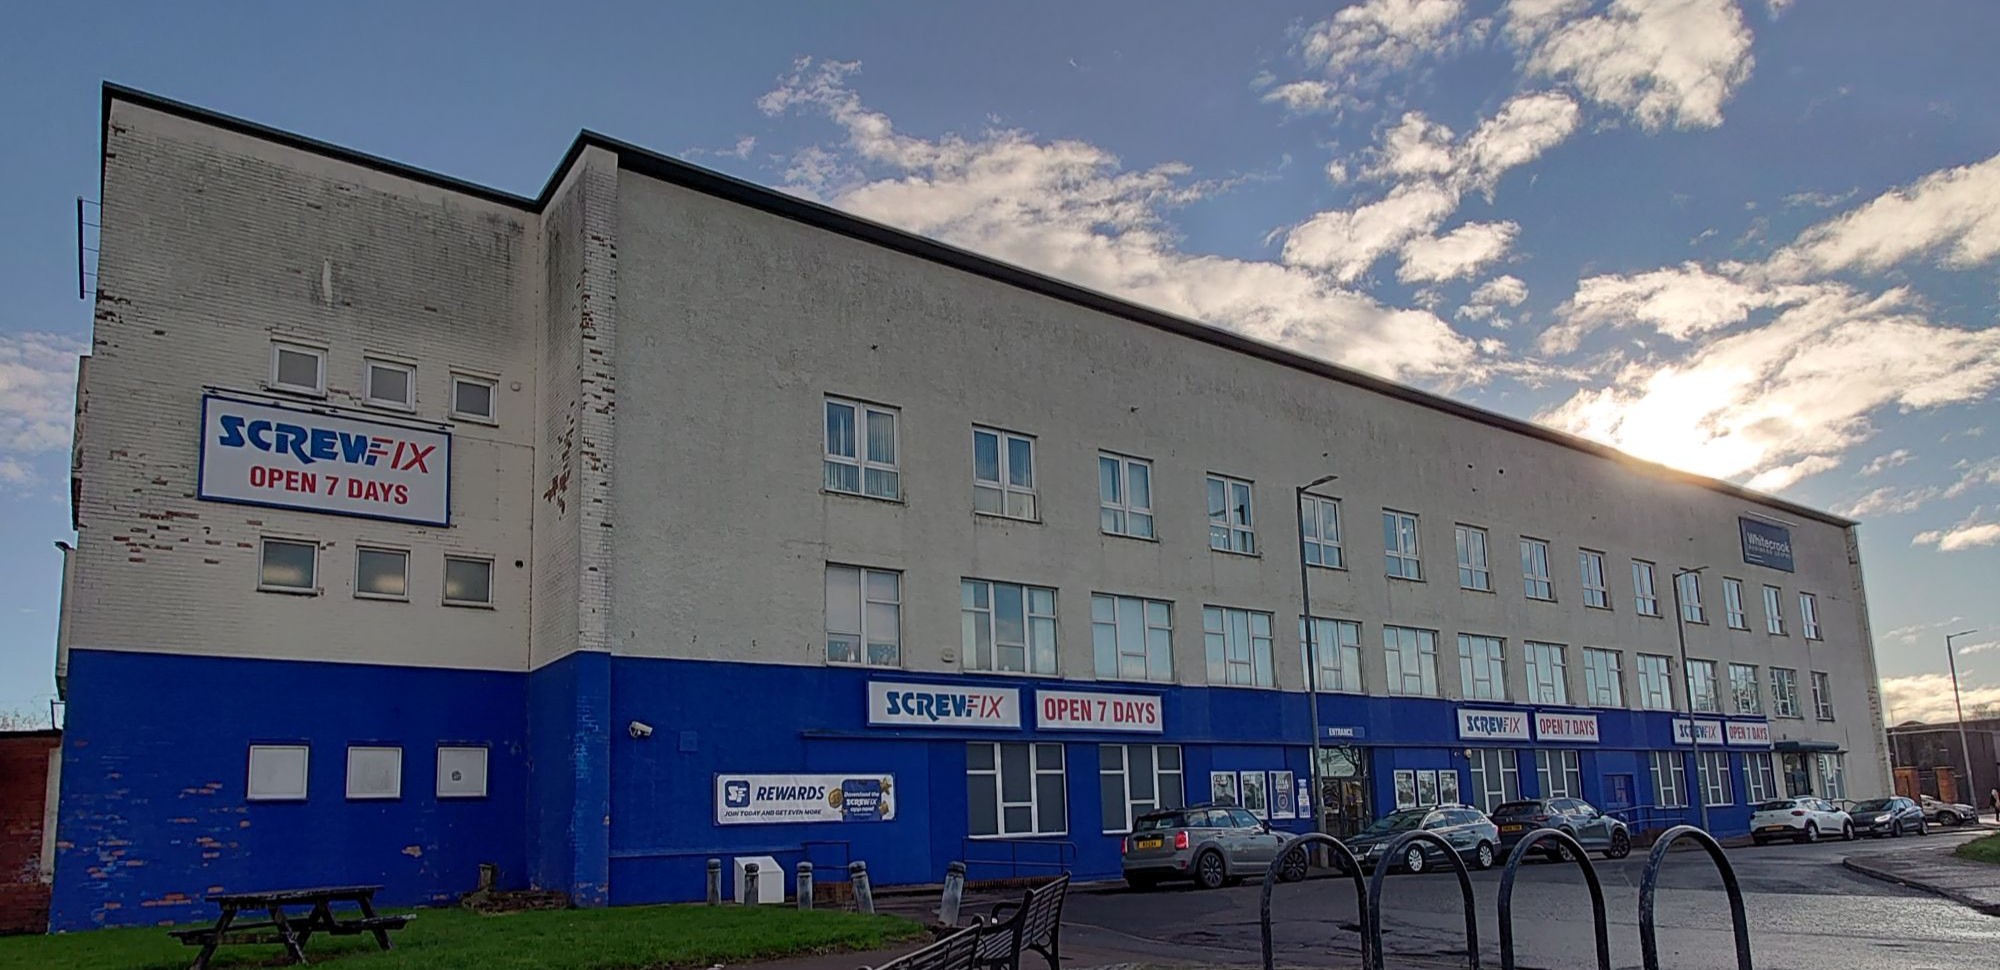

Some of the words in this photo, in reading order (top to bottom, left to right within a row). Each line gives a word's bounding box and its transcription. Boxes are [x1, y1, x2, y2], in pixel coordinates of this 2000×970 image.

[218, 415, 436, 474] SCREWFIX
[250, 465, 316, 494] OPEN
[325, 475, 339, 496] 7
[348, 478, 408, 505] DAYS
[1746, 531, 1791, 554] Whitecrook
[886, 691, 1004, 722] SCREWFIX
[1044, 697, 1092, 722] OPEN
[1097, 700, 1107, 722] 7
[1113, 701, 1156, 724] DAYS
[1328, 727, 1354, 737] ENTRANCE
[1466, 715, 1520, 736] SCREWFIX
[1540, 718, 1563, 735] OPEN
[1565, 720, 1570, 735] 7
[1573, 719, 1595, 736] DAYS
[1679, 724, 1716, 739] SCEWFIX
[1729, 725, 1746, 740] OPEN
[1746, 726, 1751, 740] 7
[1752, 726, 1768, 741] DAYS
[756, 785, 825, 801] REWARDS
